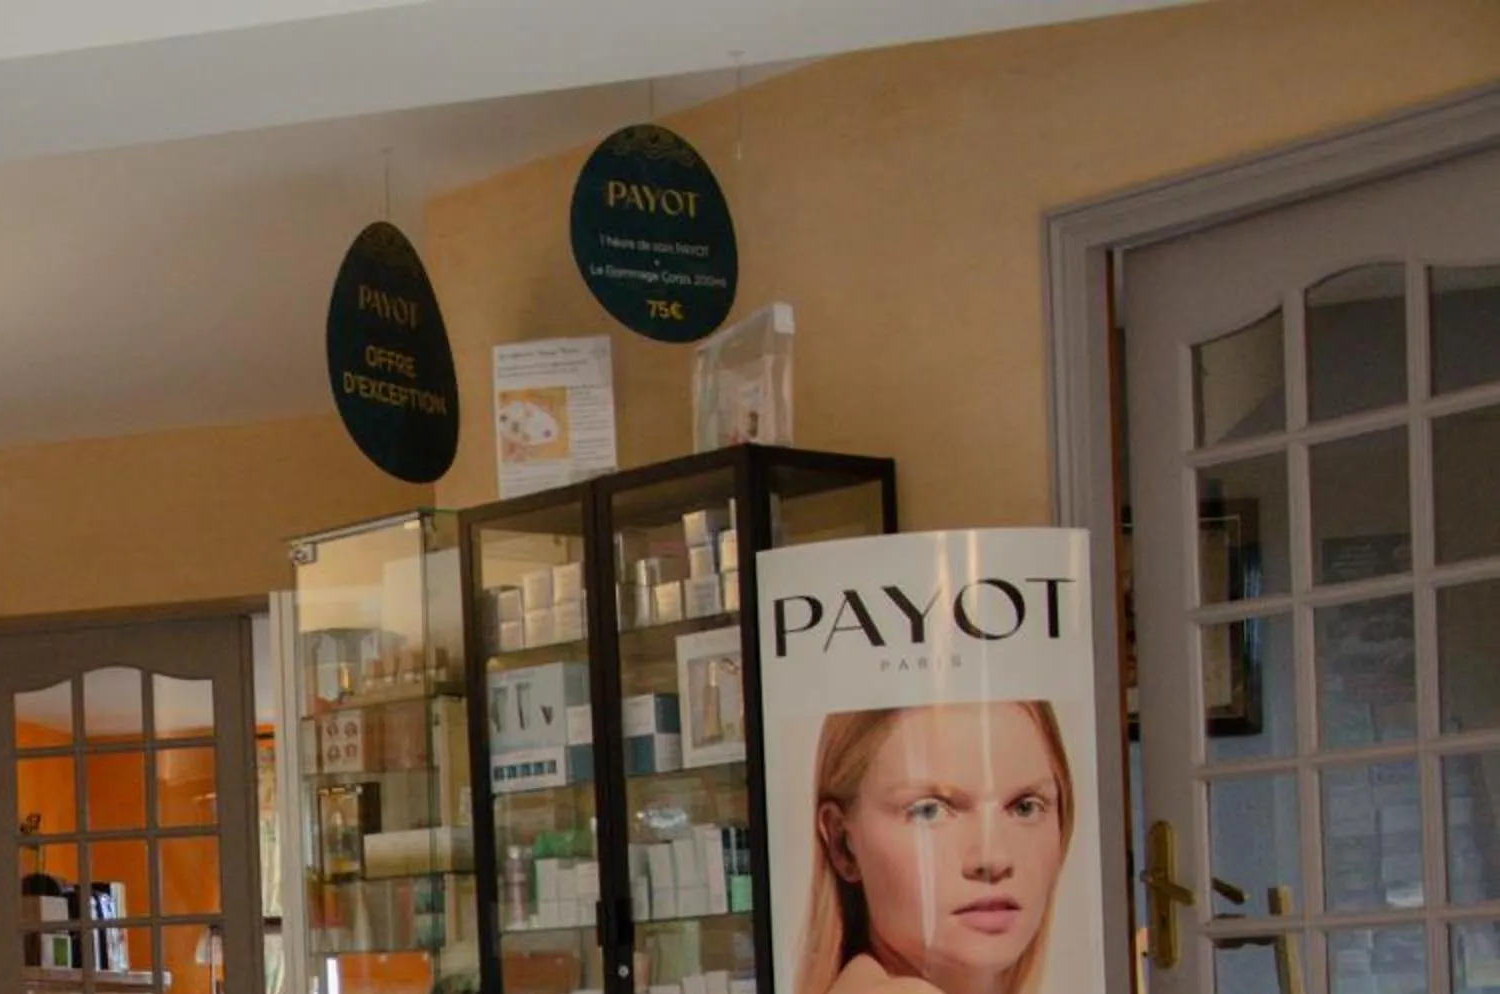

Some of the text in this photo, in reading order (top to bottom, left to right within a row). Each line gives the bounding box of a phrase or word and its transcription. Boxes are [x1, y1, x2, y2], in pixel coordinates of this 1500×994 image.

[606, 179, 699, 220] PAYOT
[606, 235, 635, 250] heure
[675, 241, 709, 257] PAYOT
[358, 284, 420, 330] PAYOT
[646, 299, 685, 320] 75€
[365, 344, 417, 379] OFFRE
[342, 370, 448, 417] D'EXCEPTION
[773, 577, 1077, 659] PAYOT
